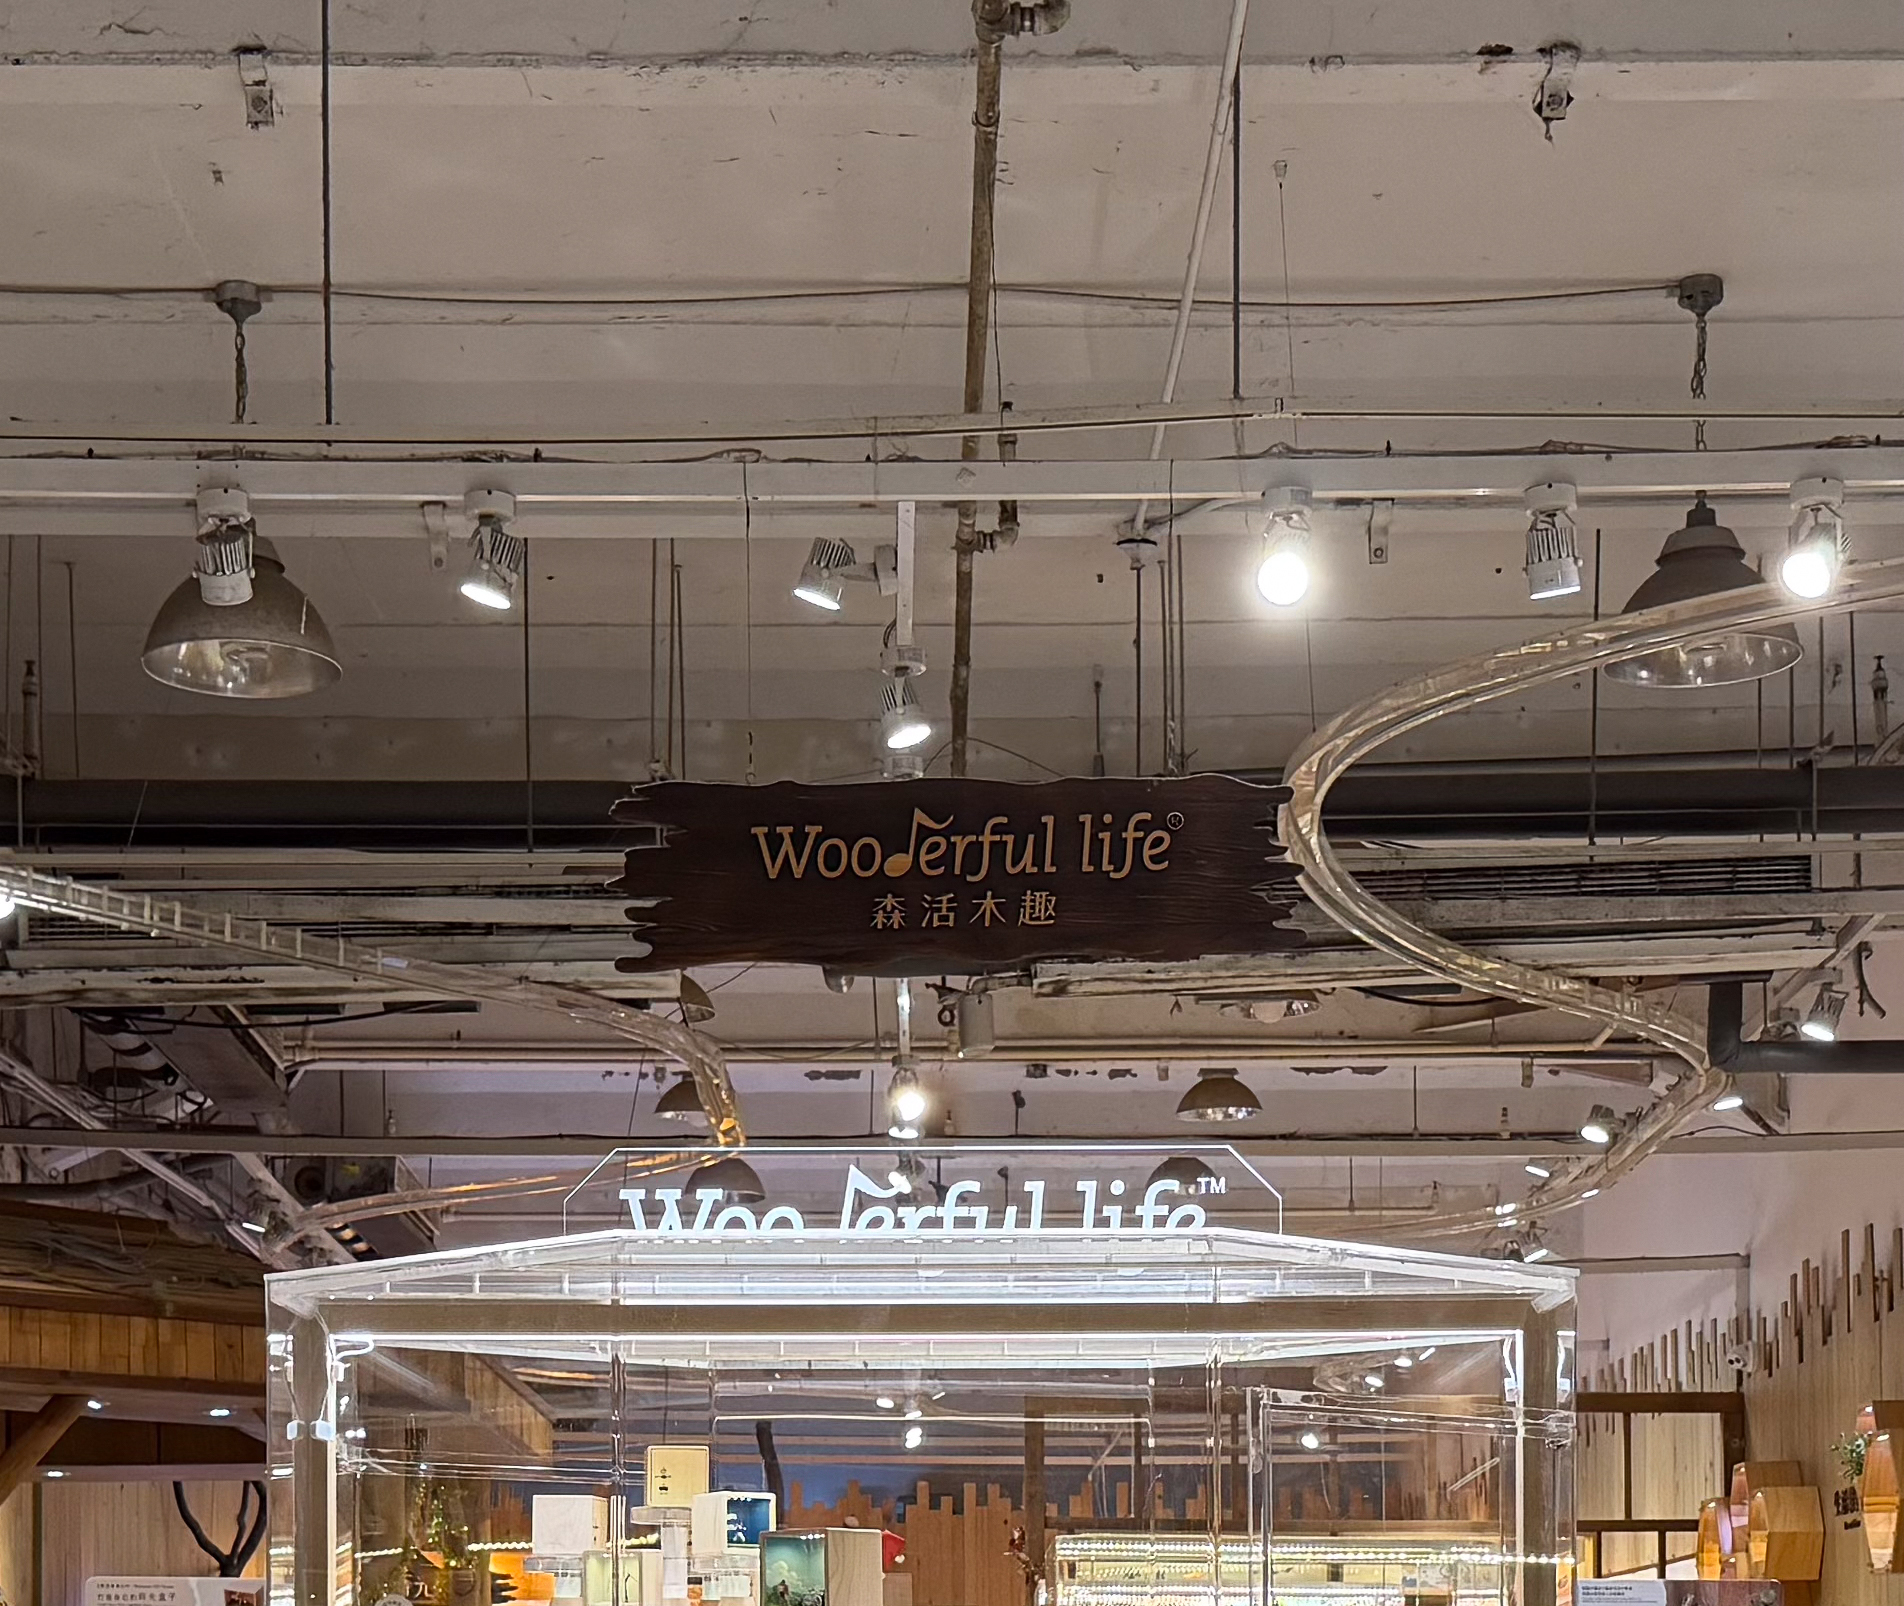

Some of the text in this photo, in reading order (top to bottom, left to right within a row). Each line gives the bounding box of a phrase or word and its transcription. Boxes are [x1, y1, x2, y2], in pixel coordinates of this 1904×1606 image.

[751, 807, 1057, 882] Wooderful
[870, 890, 1058, 930] 森活木趣
